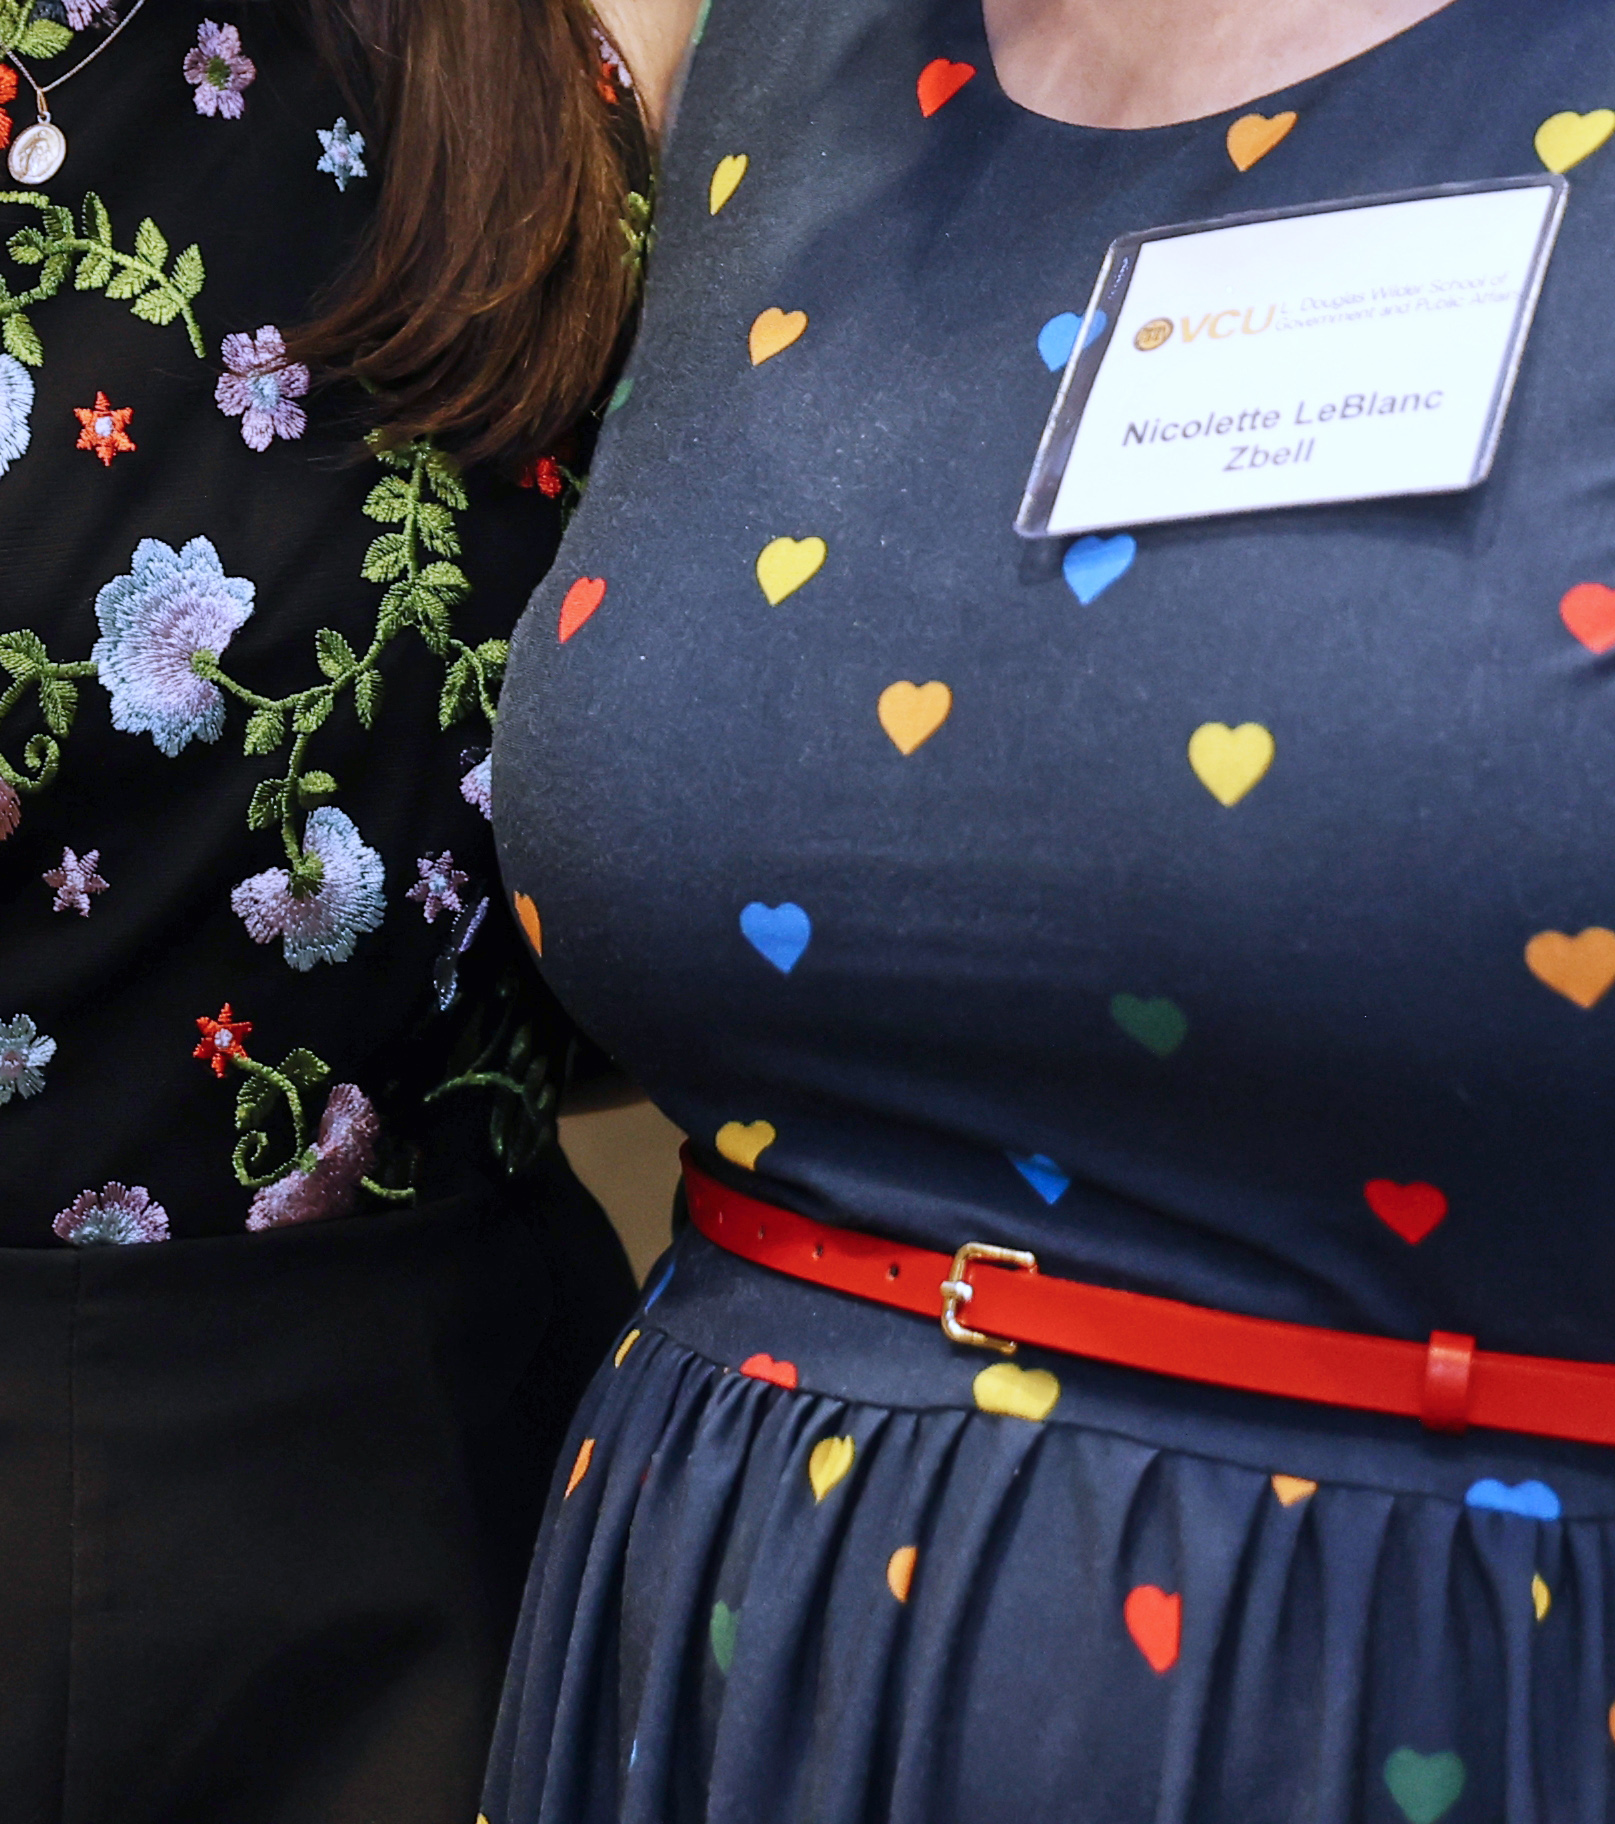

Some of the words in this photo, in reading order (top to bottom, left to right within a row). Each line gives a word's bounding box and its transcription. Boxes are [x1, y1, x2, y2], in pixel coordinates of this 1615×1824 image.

[1181, 303, 1277, 344] VCU
[1121, 407, 1281, 448] Nicolette
[1293, 389, 1445, 426] LeBlanc
[1221, 437, 1316, 473] Zbell
